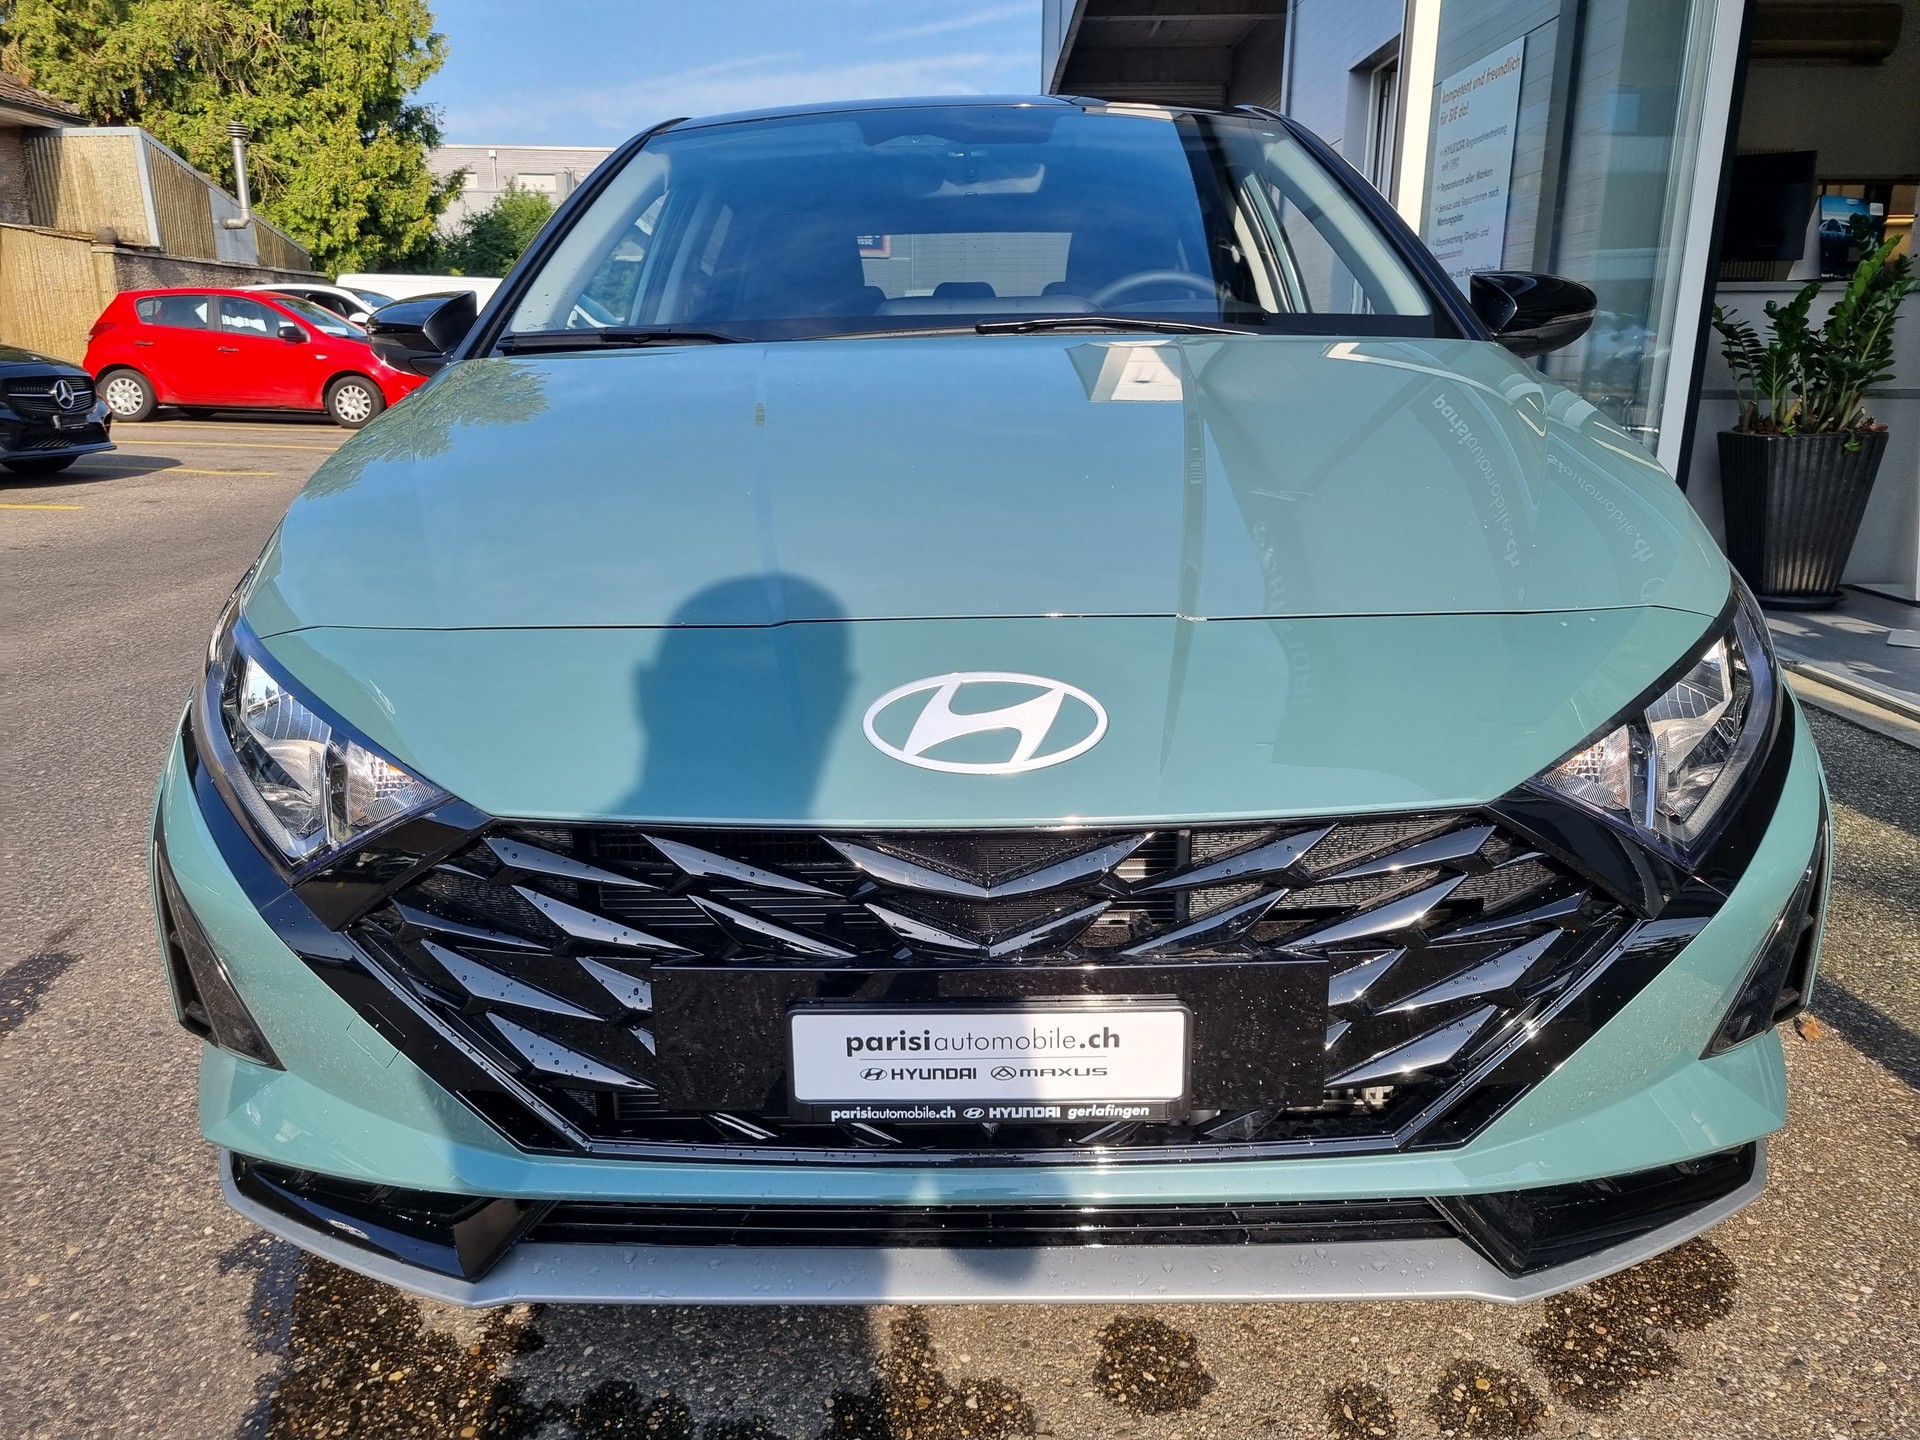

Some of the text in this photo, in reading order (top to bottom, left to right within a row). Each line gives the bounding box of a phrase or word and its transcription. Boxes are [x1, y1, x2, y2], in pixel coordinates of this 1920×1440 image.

[1442, 53, 1520, 104] kompetent und freundlich
[846, 1027, 1120, 1057] parisiautomobile.ch
[891, 1067, 1108, 1080] HYUNDAI MAXUS
[831, 1104, 1150, 1122] parisiautomobile.ch HYUNDAI gerlafingen
